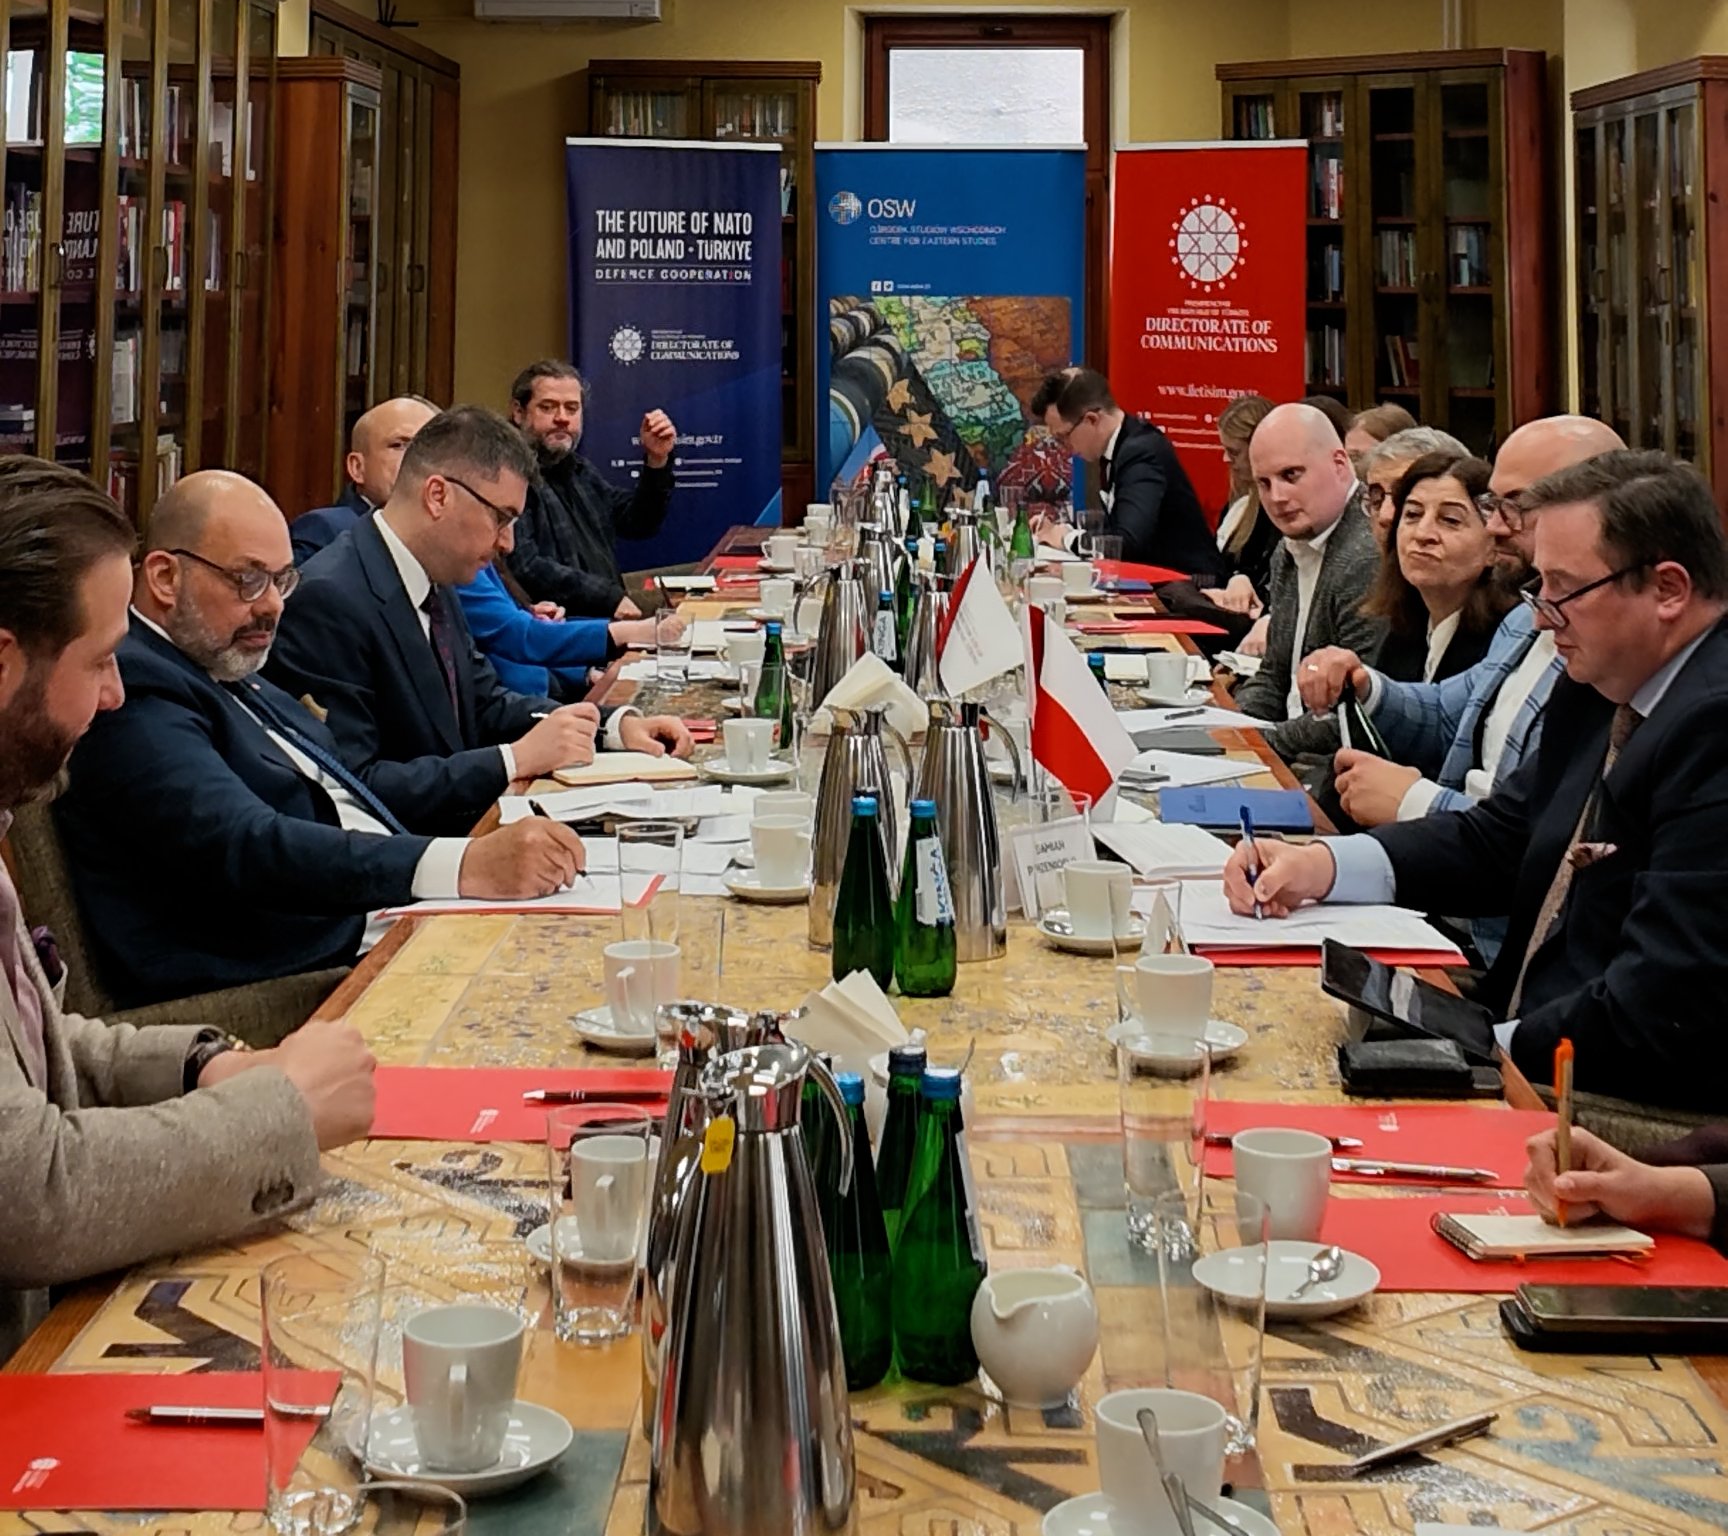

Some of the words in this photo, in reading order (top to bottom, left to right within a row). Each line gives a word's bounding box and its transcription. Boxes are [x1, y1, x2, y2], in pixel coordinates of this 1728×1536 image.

[868, 198, 916, 218] OSW
[596, 209, 625, 233] THE
[629, 210, 686, 234] FUTURE
[690, 211, 709, 234] OF
[713, 212, 752, 235] NATO
[596, 238, 625, 259] AND
[630, 238, 685, 260] POLAND
[595, 268, 655, 280] DEFENCE
[660, 269, 752, 281] COOPERATION
[1146, 317, 1249, 334] DIRECTORATE
[1251, 320, 1272, 335] OF
[1140, 334, 1278, 353] COMMUNICATIONS
